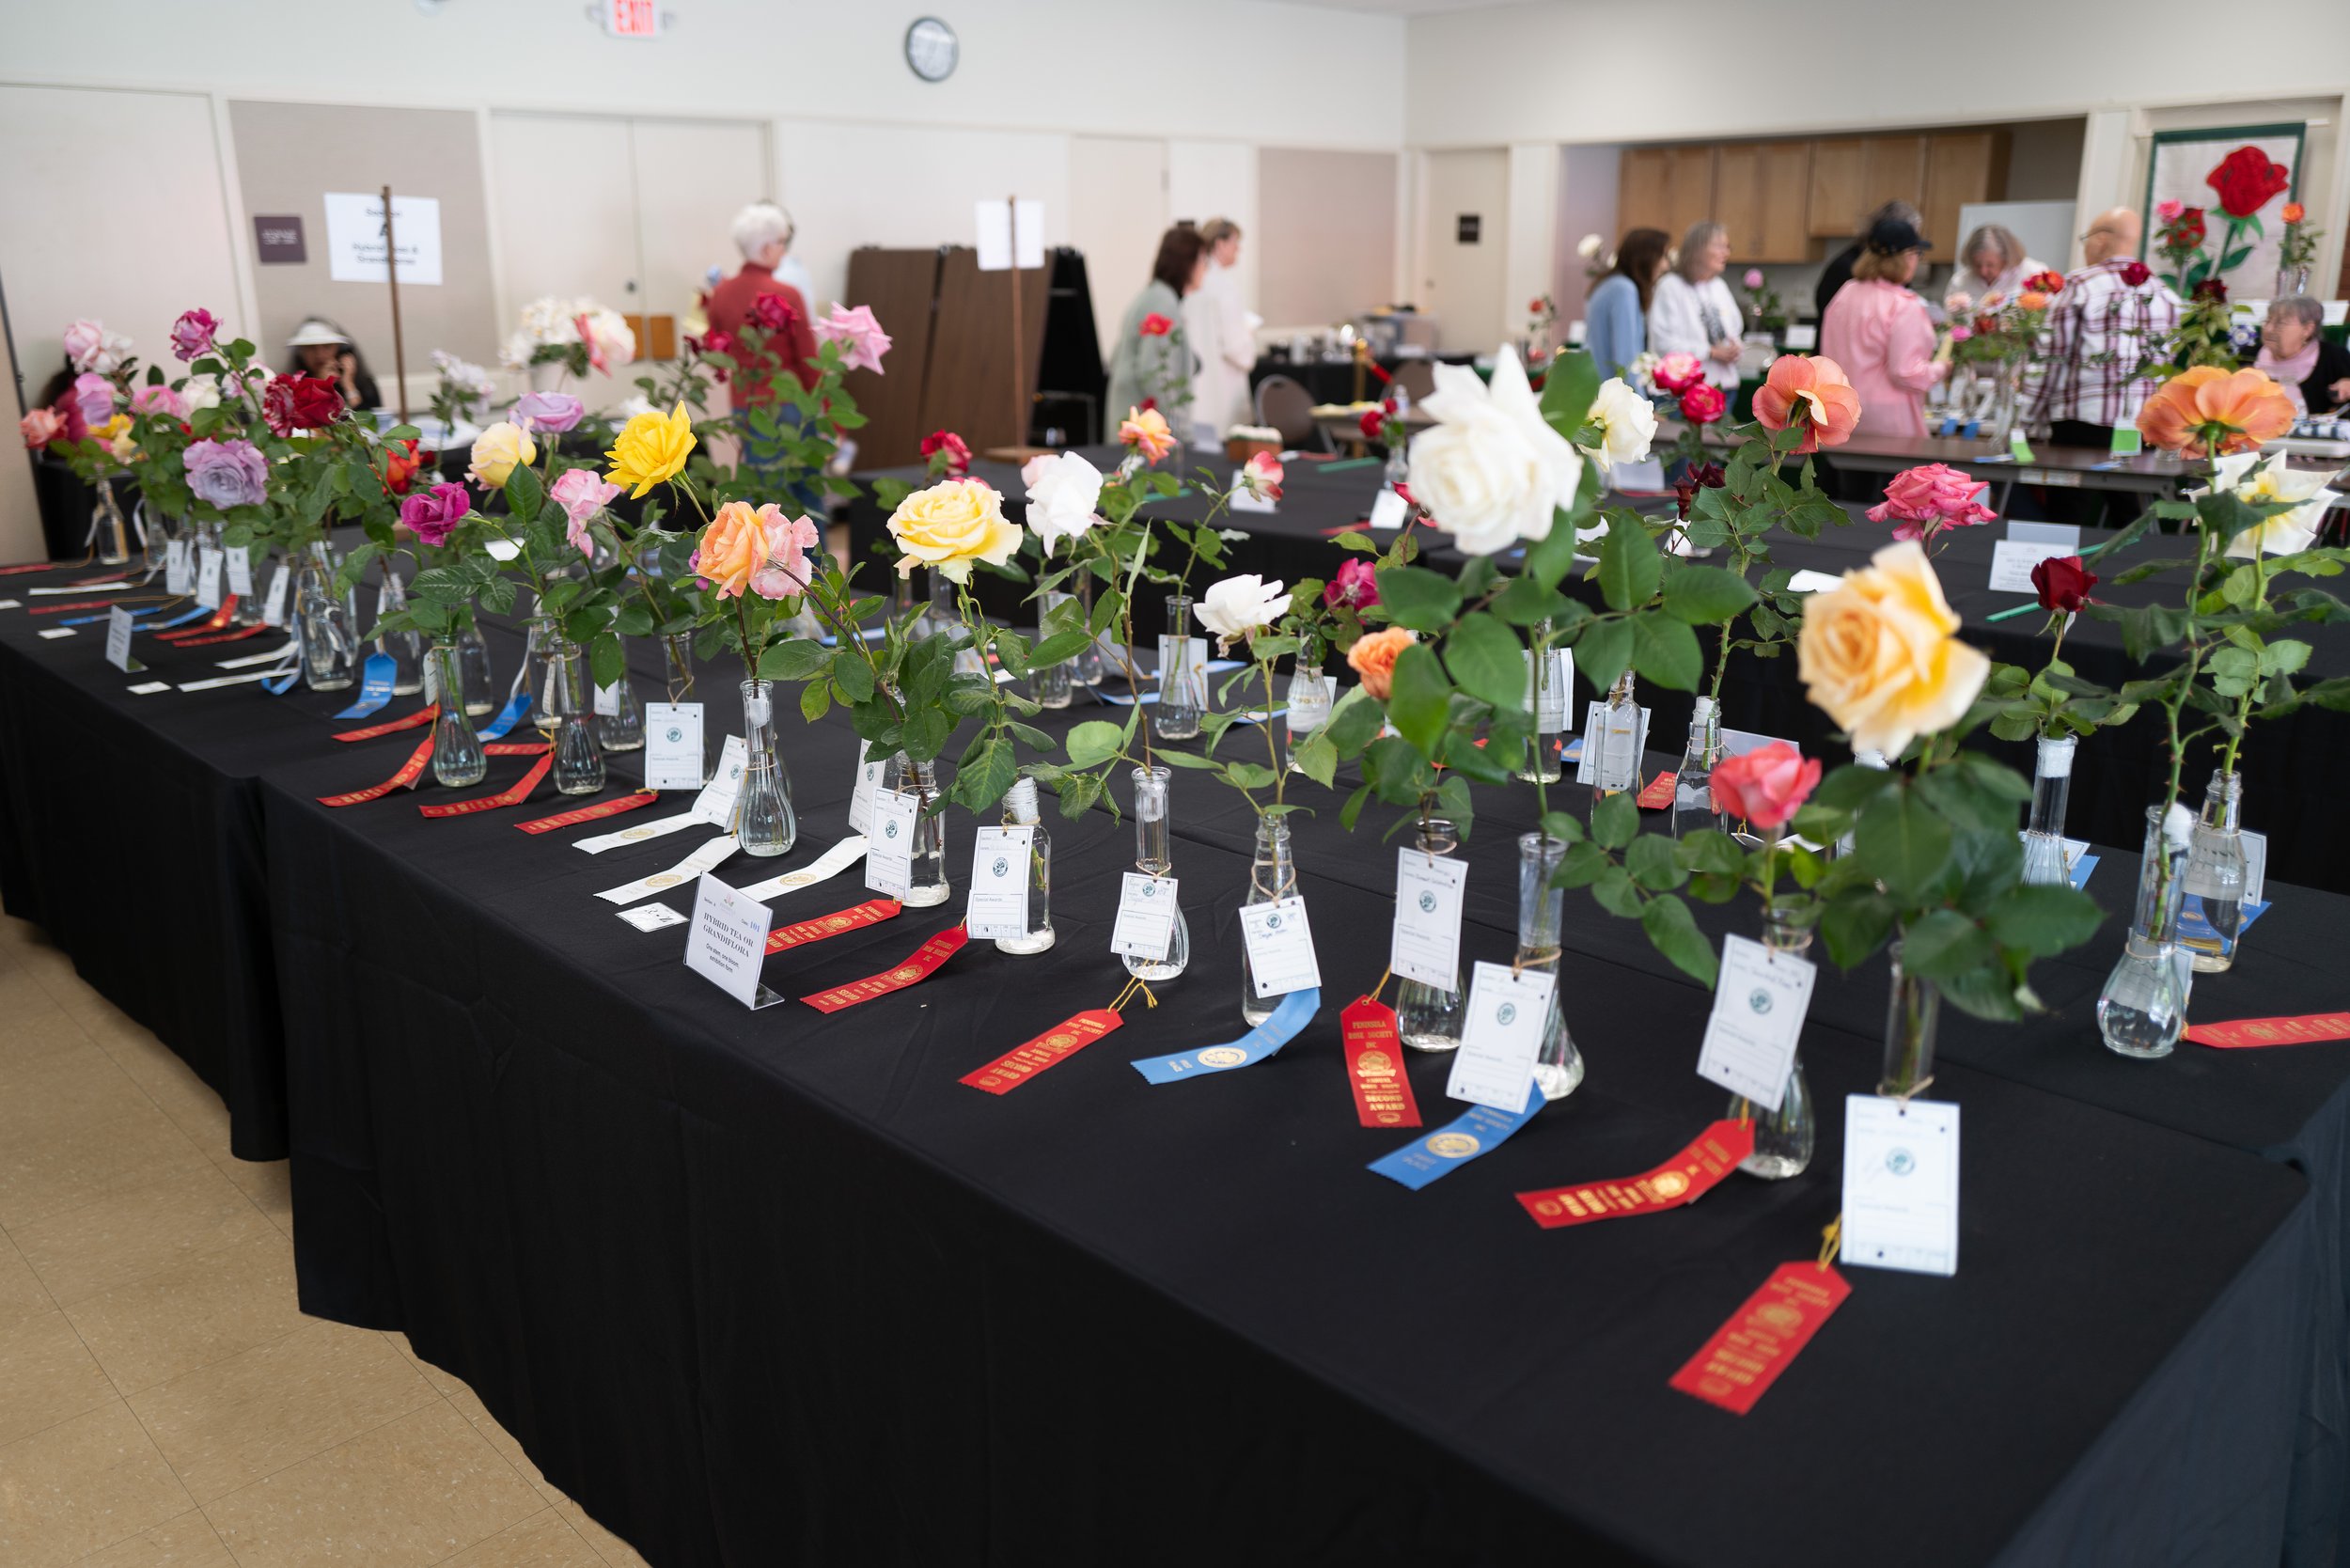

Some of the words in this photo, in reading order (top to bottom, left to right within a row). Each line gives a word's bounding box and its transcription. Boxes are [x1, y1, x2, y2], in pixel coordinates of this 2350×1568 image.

[614, 0, 655, 34] EXIT
[703, 912, 728, 932] HYBRID
[729, 927, 742, 941] TEA
[743, 936, 753, 948] OR
[750, 920, 760, 933] 101
[703, 924, 749, 957] GRANDIFLORA
[1352, 1020, 1387, 1029] PENINSULA
[1368, 1030, 1394, 1039] SOCIETY
[1000, 1060, 1033, 1074] SECOND
[1364, 1094, 1403, 1103] SECOND
[1369, 1103, 1406, 1111] AWARD
